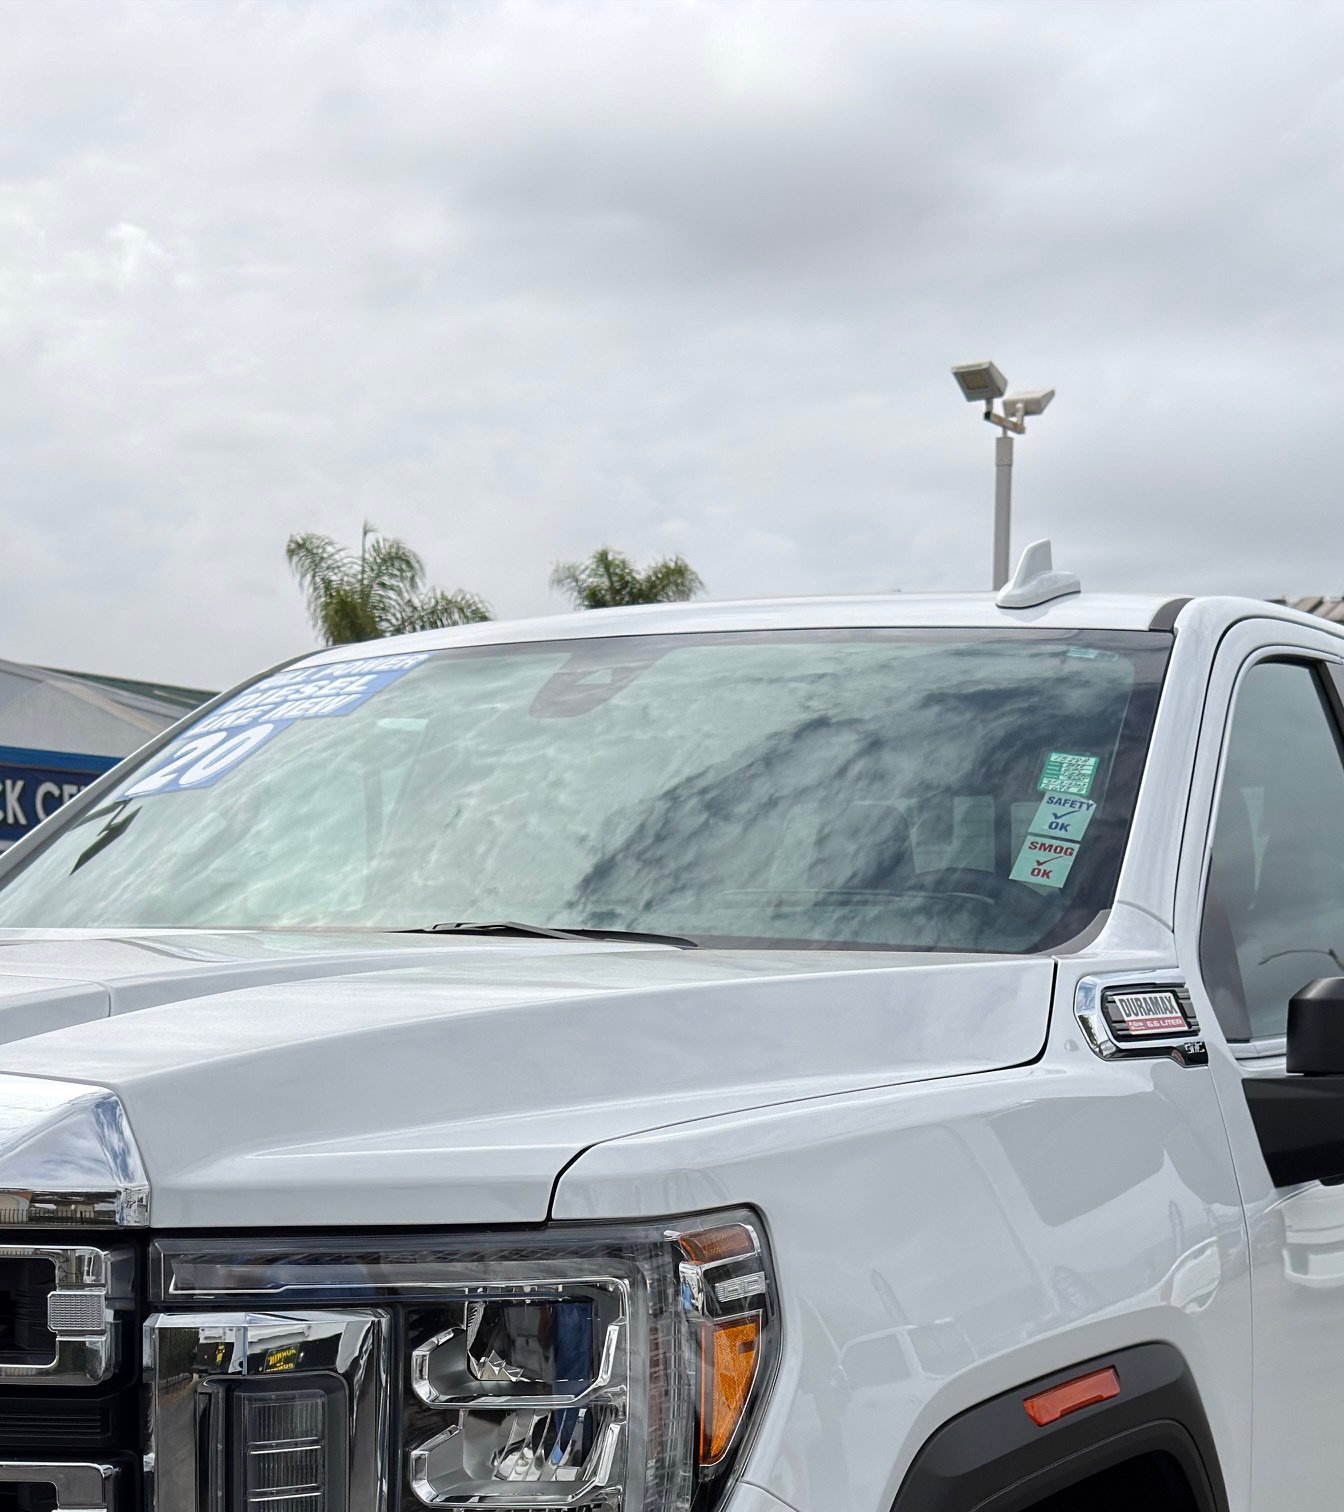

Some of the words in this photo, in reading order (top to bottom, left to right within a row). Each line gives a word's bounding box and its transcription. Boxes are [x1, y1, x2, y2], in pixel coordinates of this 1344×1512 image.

[220, 674, 379, 716] DIESEL
[258, 693, 363, 722] NEW
[124, 723, 275, 796] 20
[1046, 796, 1094, 811] SAFETY
[1048, 821, 1071, 833] OK
[1028, 841, 1075, 857] SMOG
[1030, 867, 1054, 879] OK
[1118, 996, 1178, 1017] DURAMAX
[1160, 1019, 1183, 1027] LITER
